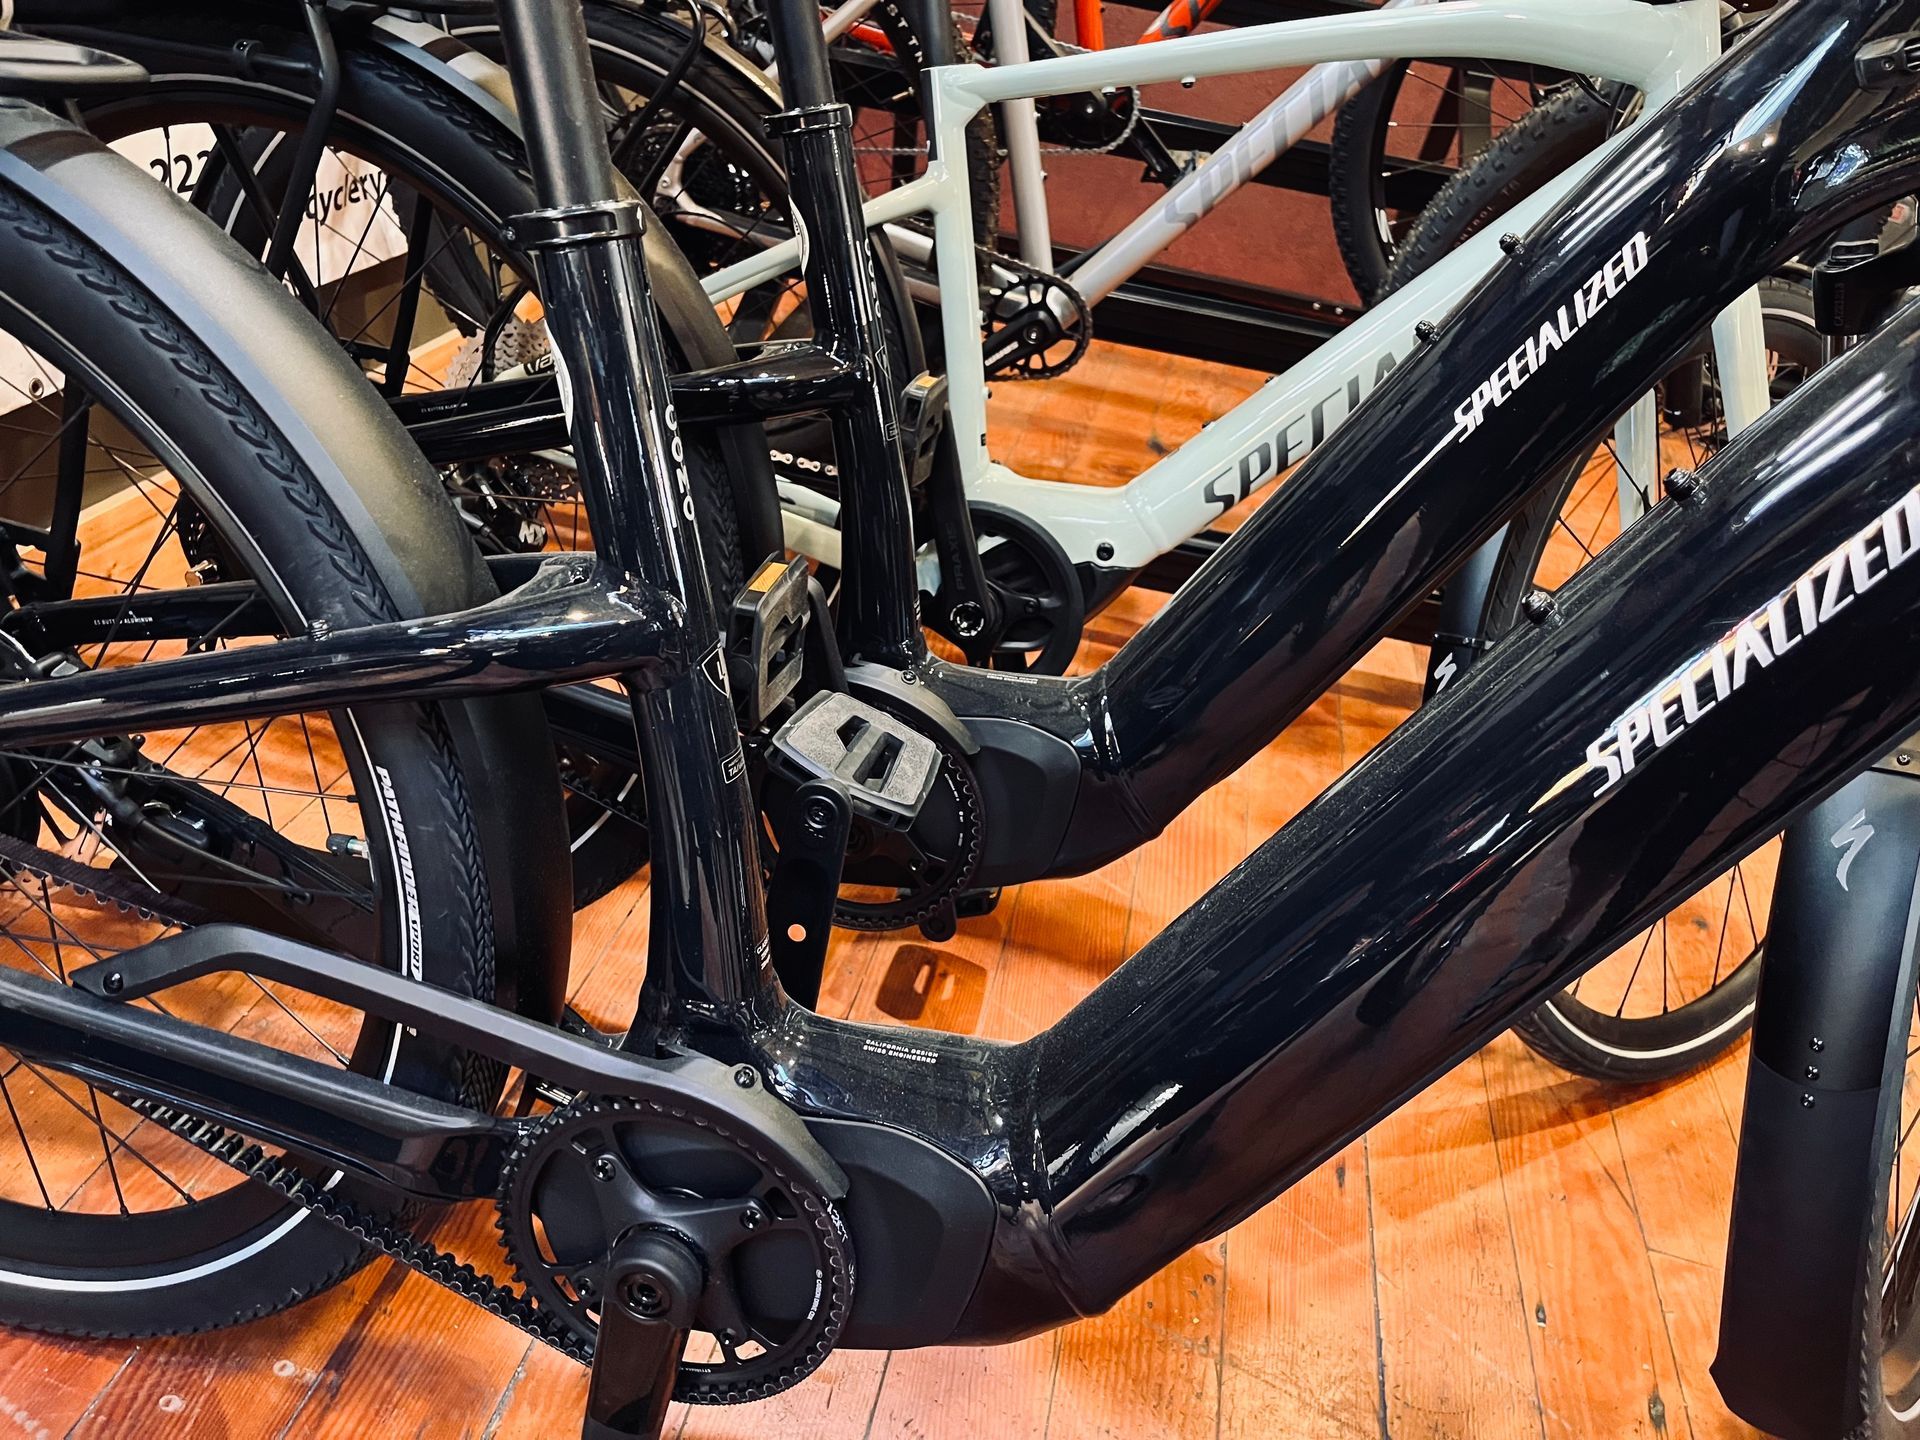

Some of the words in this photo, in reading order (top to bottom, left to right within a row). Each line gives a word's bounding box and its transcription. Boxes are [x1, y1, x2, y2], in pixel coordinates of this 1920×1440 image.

[1203, 334, 1421, 523] SPECIA
[1585, 485, 1920, 799] SPECIALIZED
[375, 765, 419, 914] PATHFINDER
[409, 916, 421, 973] SPORT
[863, 1045, 886, 1055] SWISS
[888, 1050, 937, 1064] ENGINEERED
[865, 1039, 909, 1053] CALIFORNIA
[910, 1048, 939, 1058] DESIGN
